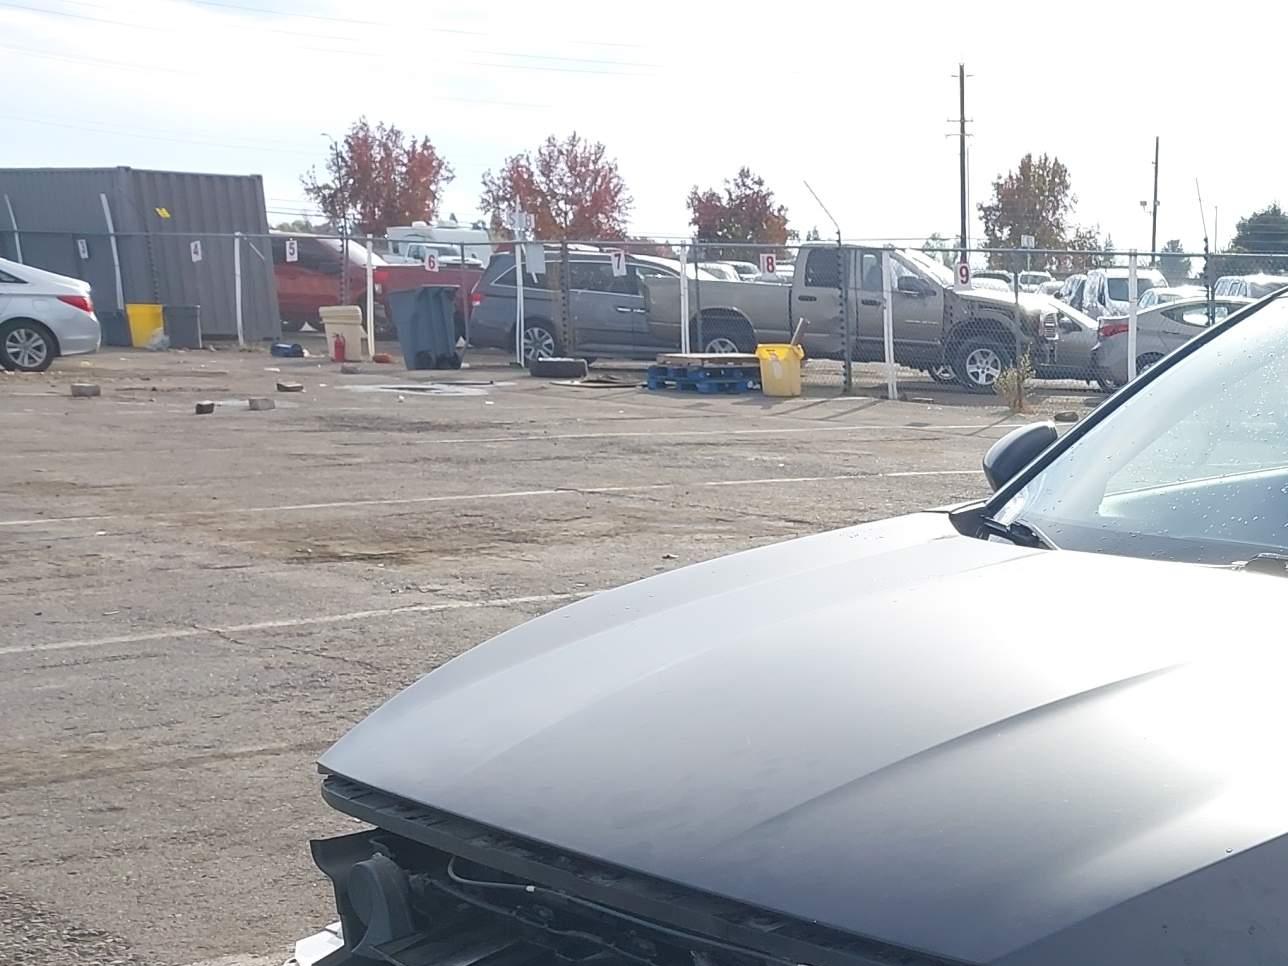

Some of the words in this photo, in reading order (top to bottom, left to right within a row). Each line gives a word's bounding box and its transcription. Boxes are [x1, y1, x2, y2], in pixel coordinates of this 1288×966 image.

[288, 241, 296, 257] 5
[428, 254, 436, 270] 6
[614, 252, 622, 270] 7
[766, 255, 775, 273] 8
[958, 265, 970, 285] 9
